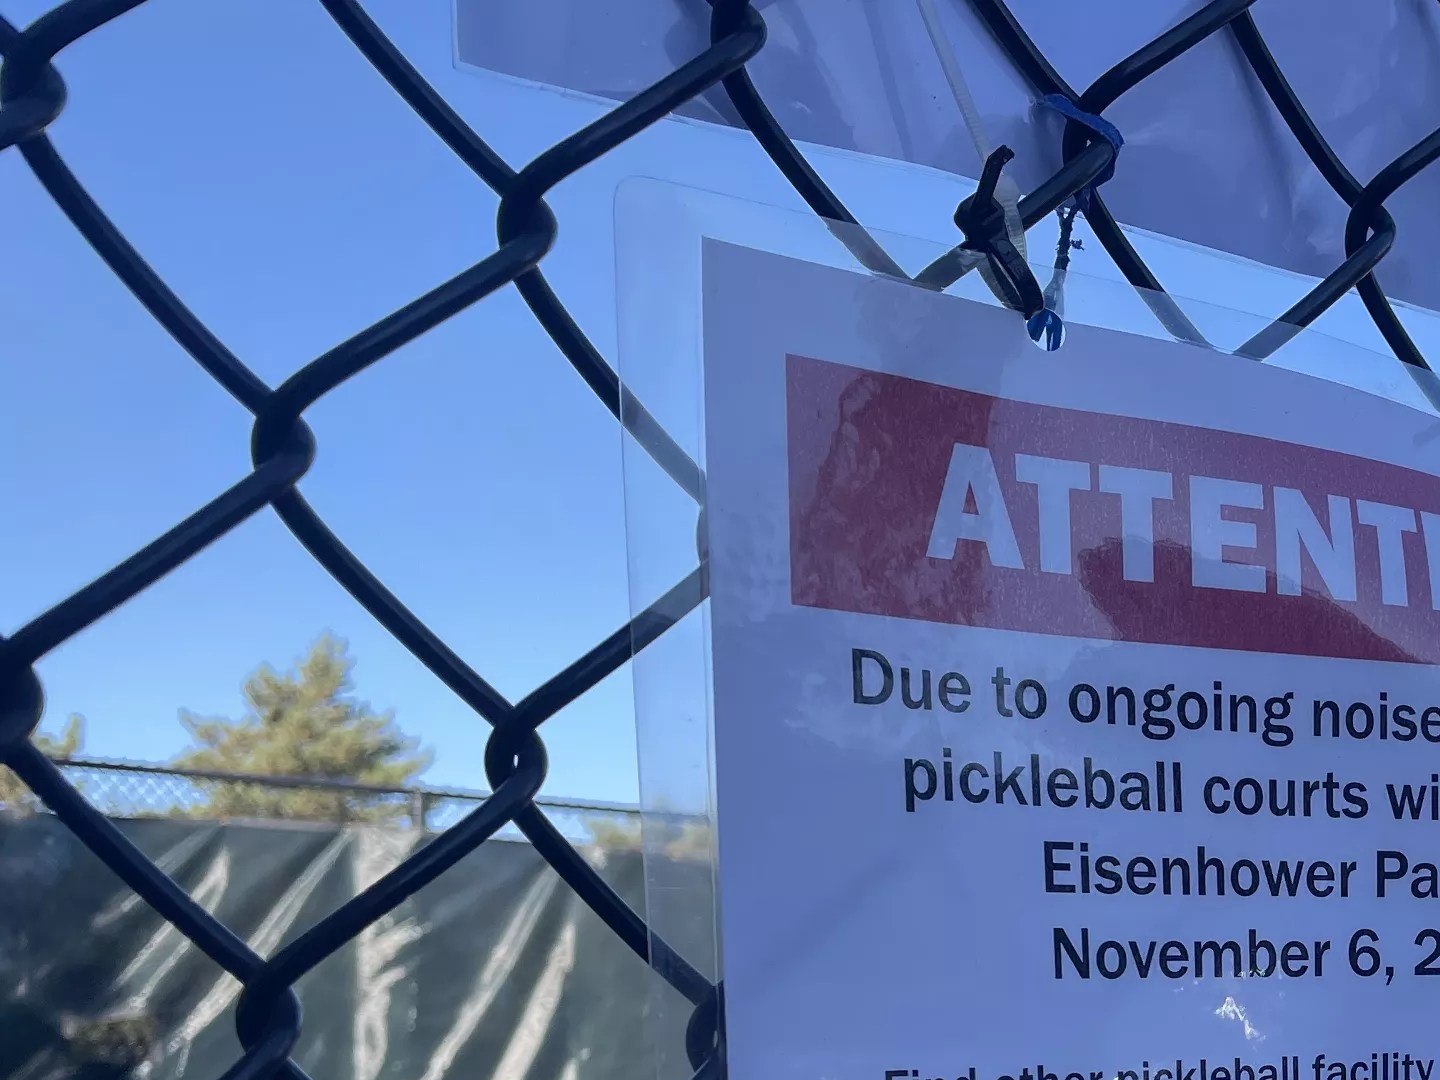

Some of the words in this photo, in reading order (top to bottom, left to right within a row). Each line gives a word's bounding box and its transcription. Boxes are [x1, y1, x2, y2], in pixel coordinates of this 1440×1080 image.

[852, 648, 971, 713] Due
[992, 667, 1047, 719] to
[1069, 681, 1294, 747] ongoing
[904, 748, 1182, 812] pickleball
[1204, 772, 1368, 819] courts
[1044, 841, 1357, 897] Eisenhower
[1053, 928, 1330, 979] November
[1349, 929, 1394, 986] 6,
